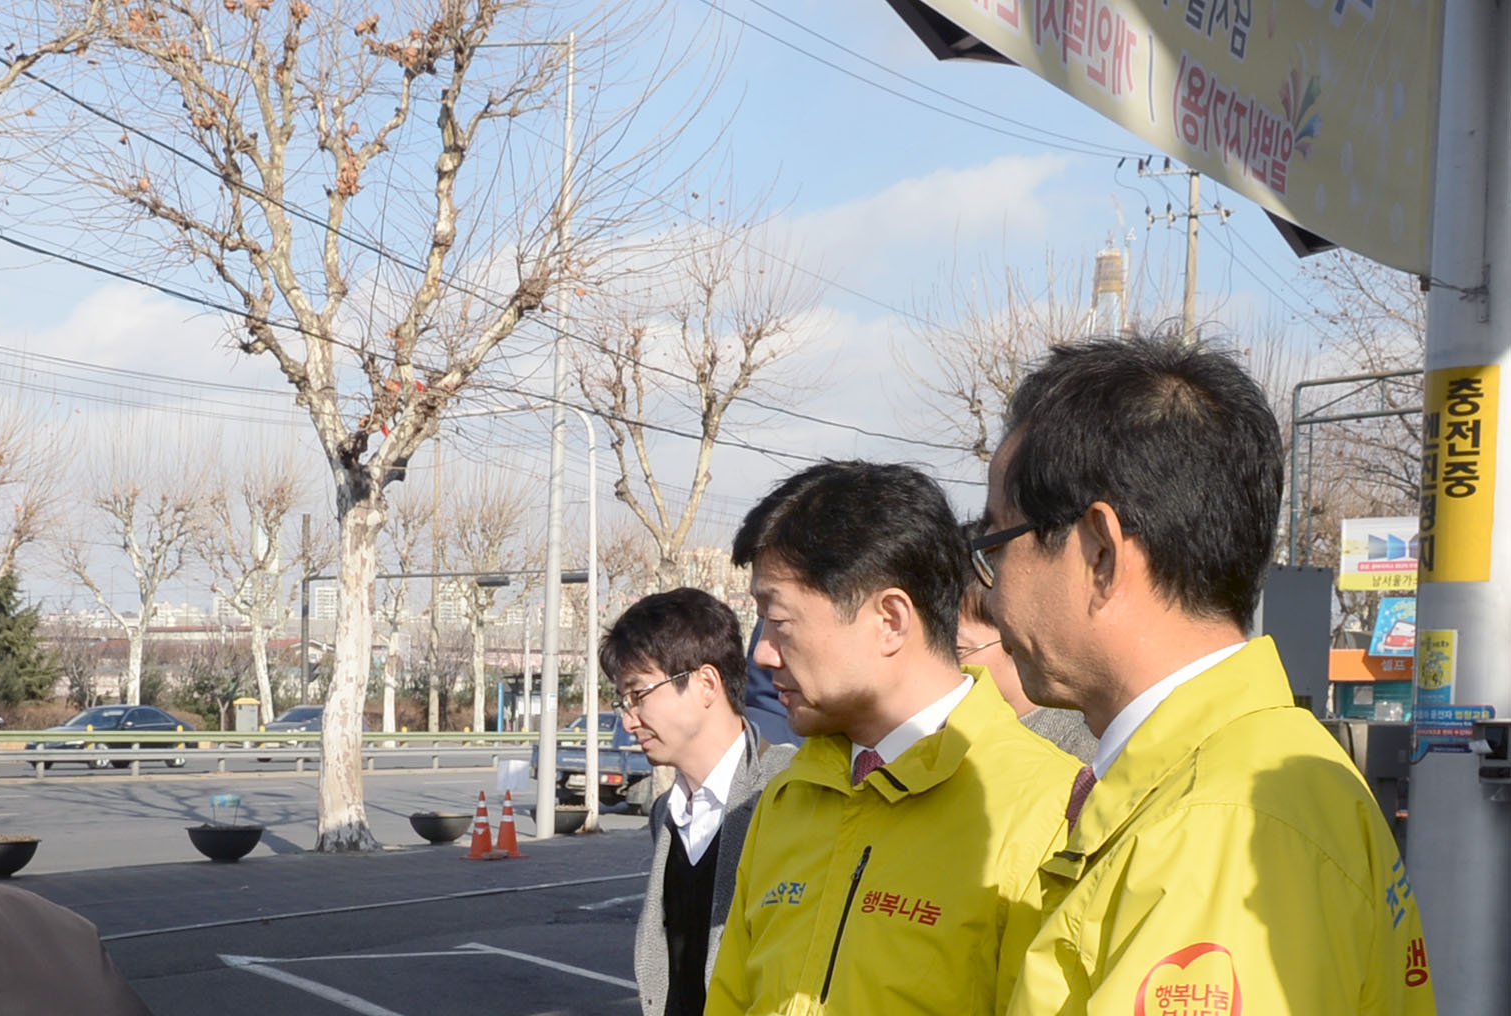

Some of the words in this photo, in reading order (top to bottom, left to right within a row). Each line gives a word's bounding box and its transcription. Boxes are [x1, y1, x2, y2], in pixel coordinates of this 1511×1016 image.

[1442, 377, 1484, 499] 충전중
[861, 890, 942, 926] 행복나눔
[1155, 983, 1229, 1011] 행복나눔
